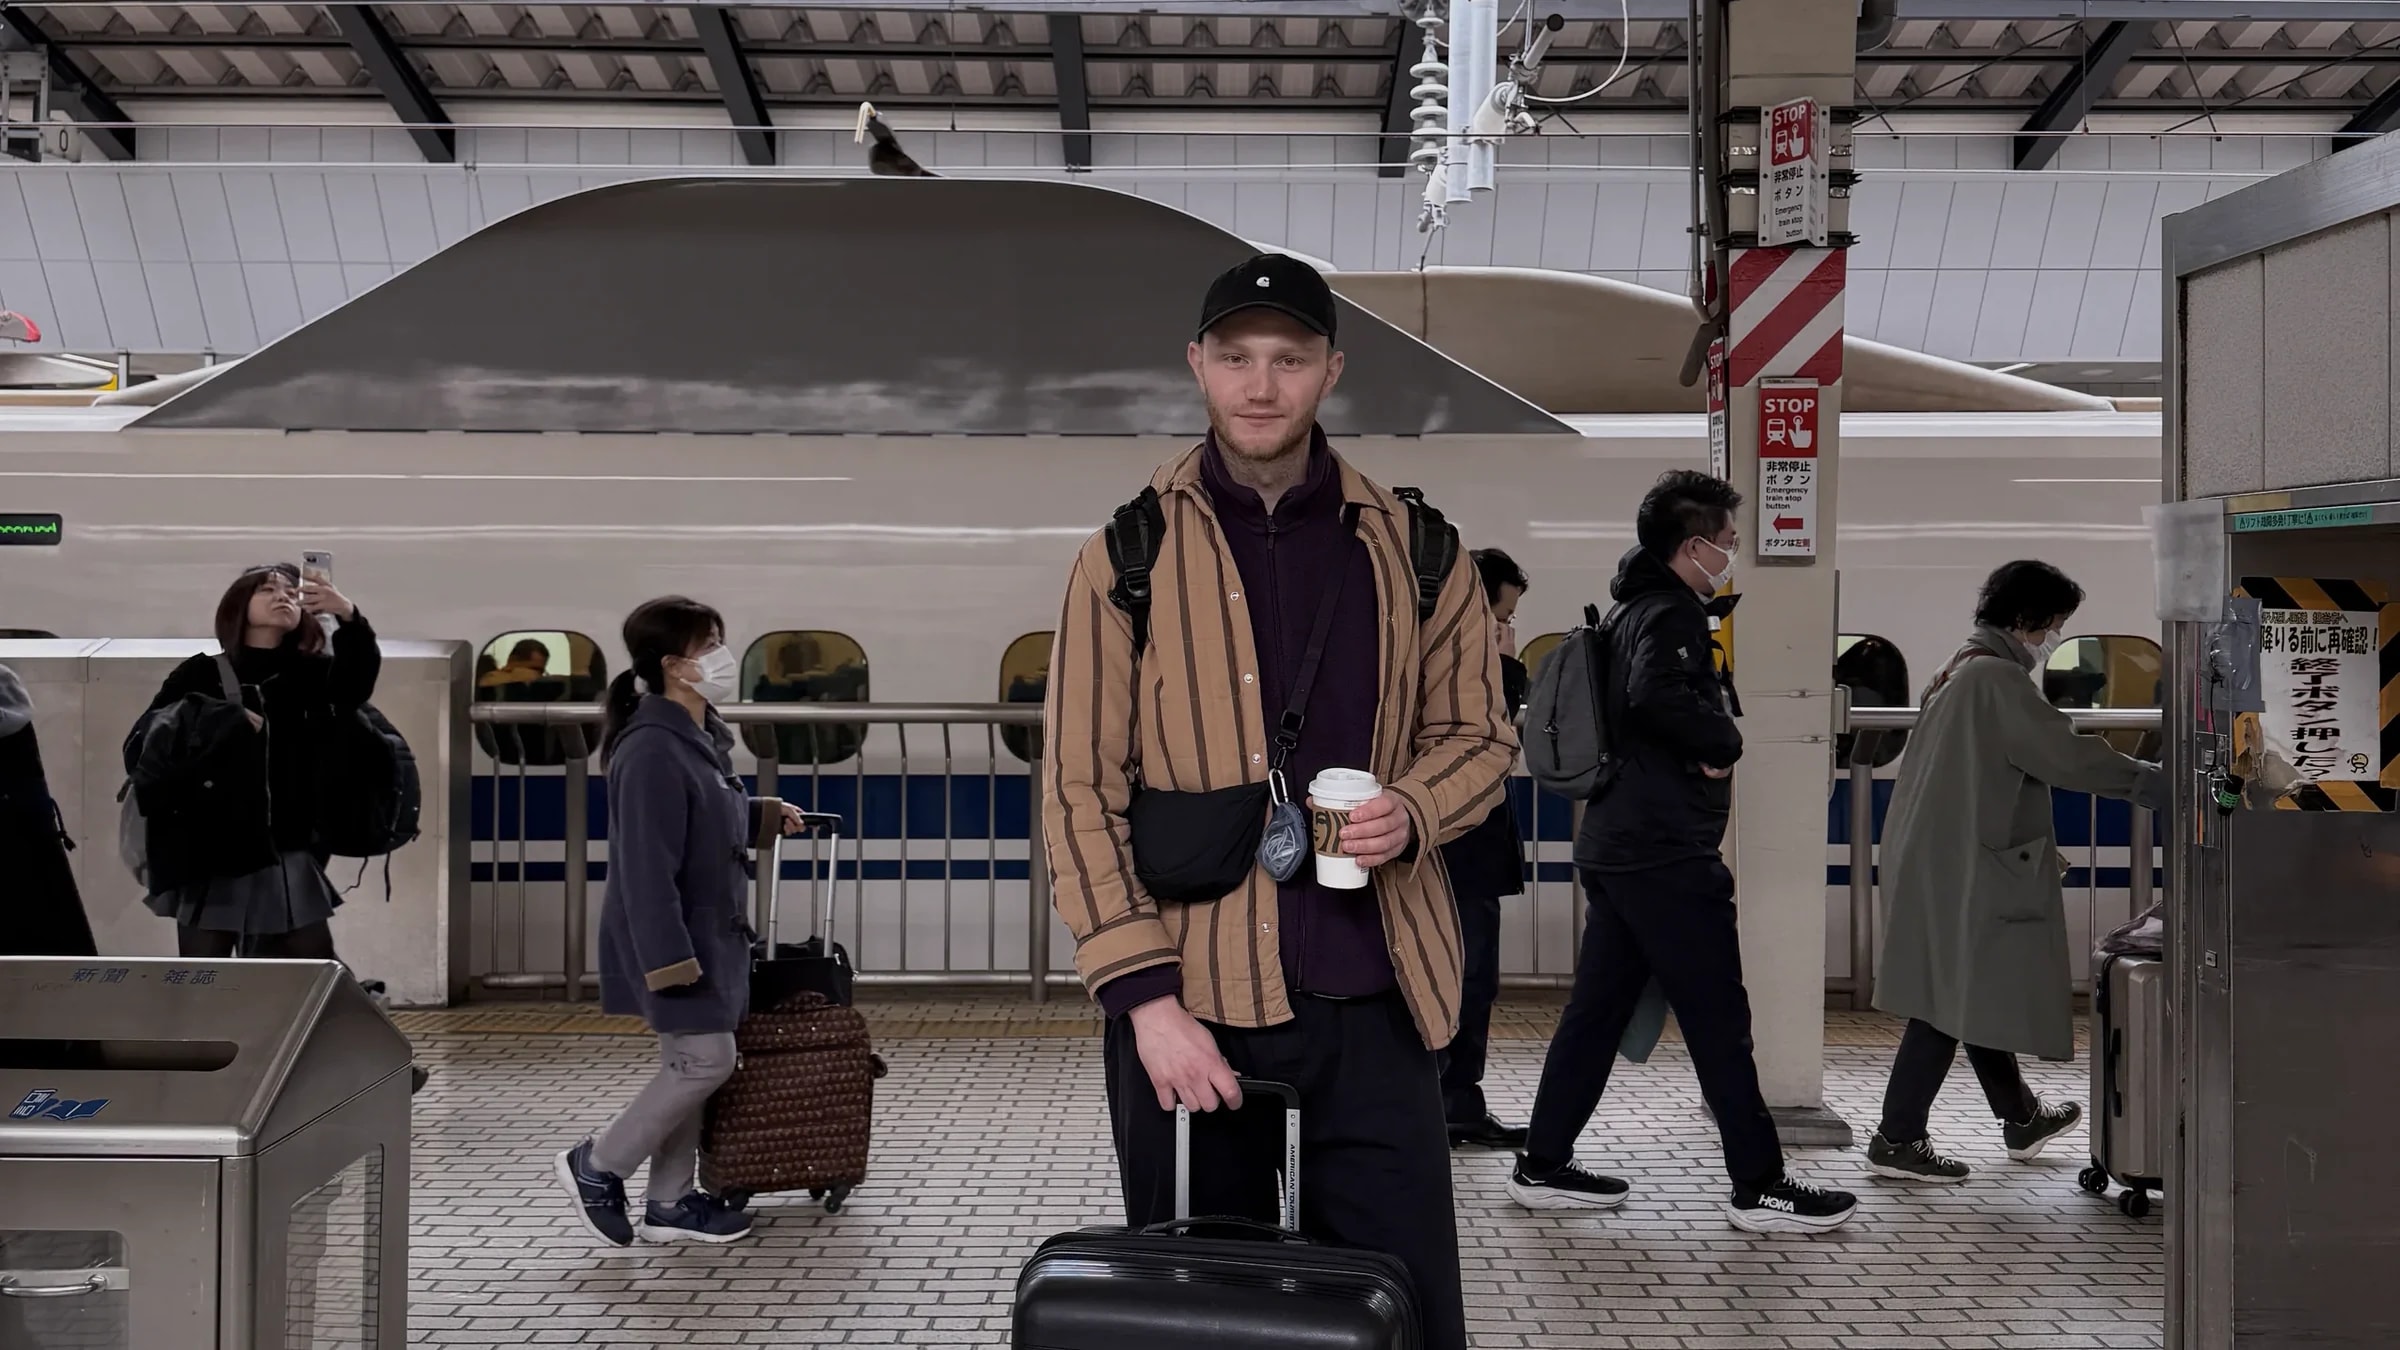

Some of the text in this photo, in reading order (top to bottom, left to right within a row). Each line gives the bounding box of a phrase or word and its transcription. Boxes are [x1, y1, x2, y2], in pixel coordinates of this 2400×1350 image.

[1774, 105, 1806, 126] STOP
[1774, 165, 1804, 184] 非常停止
[1774, 185, 1804, 202] ボタン
[1775, 203, 1803, 216] Emergency
[1779, 215, 1803, 228] train stop
[1786, 228, 1803, 238] button
[1710, 352, 1723, 370] STOP
[1764, 398, 1816, 413] STOP
[1765, 461, 1811, 473] 非常停止
[1765, 474, 1811, 485] ボタン
[1765, 486, 1809, 495] Emergency
[1765, 494, 1802, 503] train stop
[1765, 502, 1791, 510] button
[1764, 537, 1811, 548] ボタンは左側
[1758, 1194, 1794, 1212] HOKA
